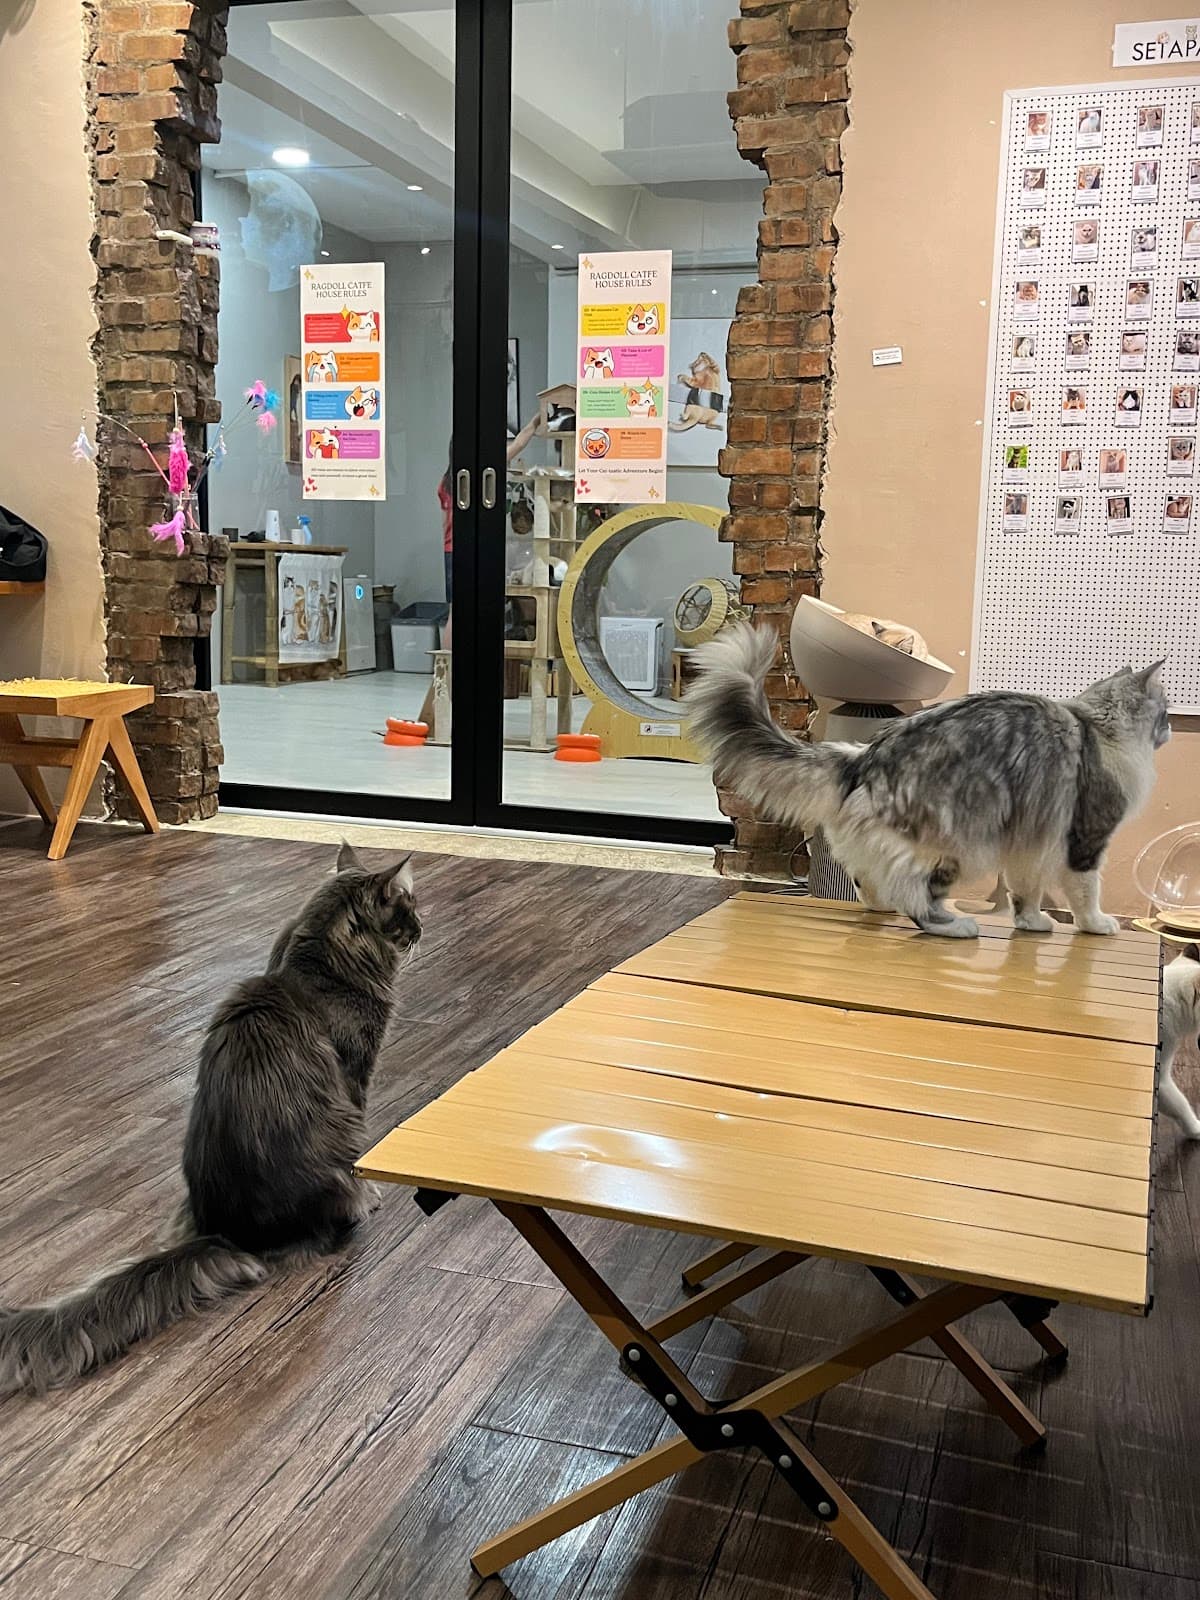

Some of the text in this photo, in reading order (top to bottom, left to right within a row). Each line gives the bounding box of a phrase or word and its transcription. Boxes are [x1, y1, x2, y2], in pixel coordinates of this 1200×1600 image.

[590, 272, 630, 280] RAGDOLL
[311, 282, 345, 290] RAGDOLL
[595, 279, 652, 289] HOUSE RULES
[316, 289, 367, 298] HOUSE RULES
